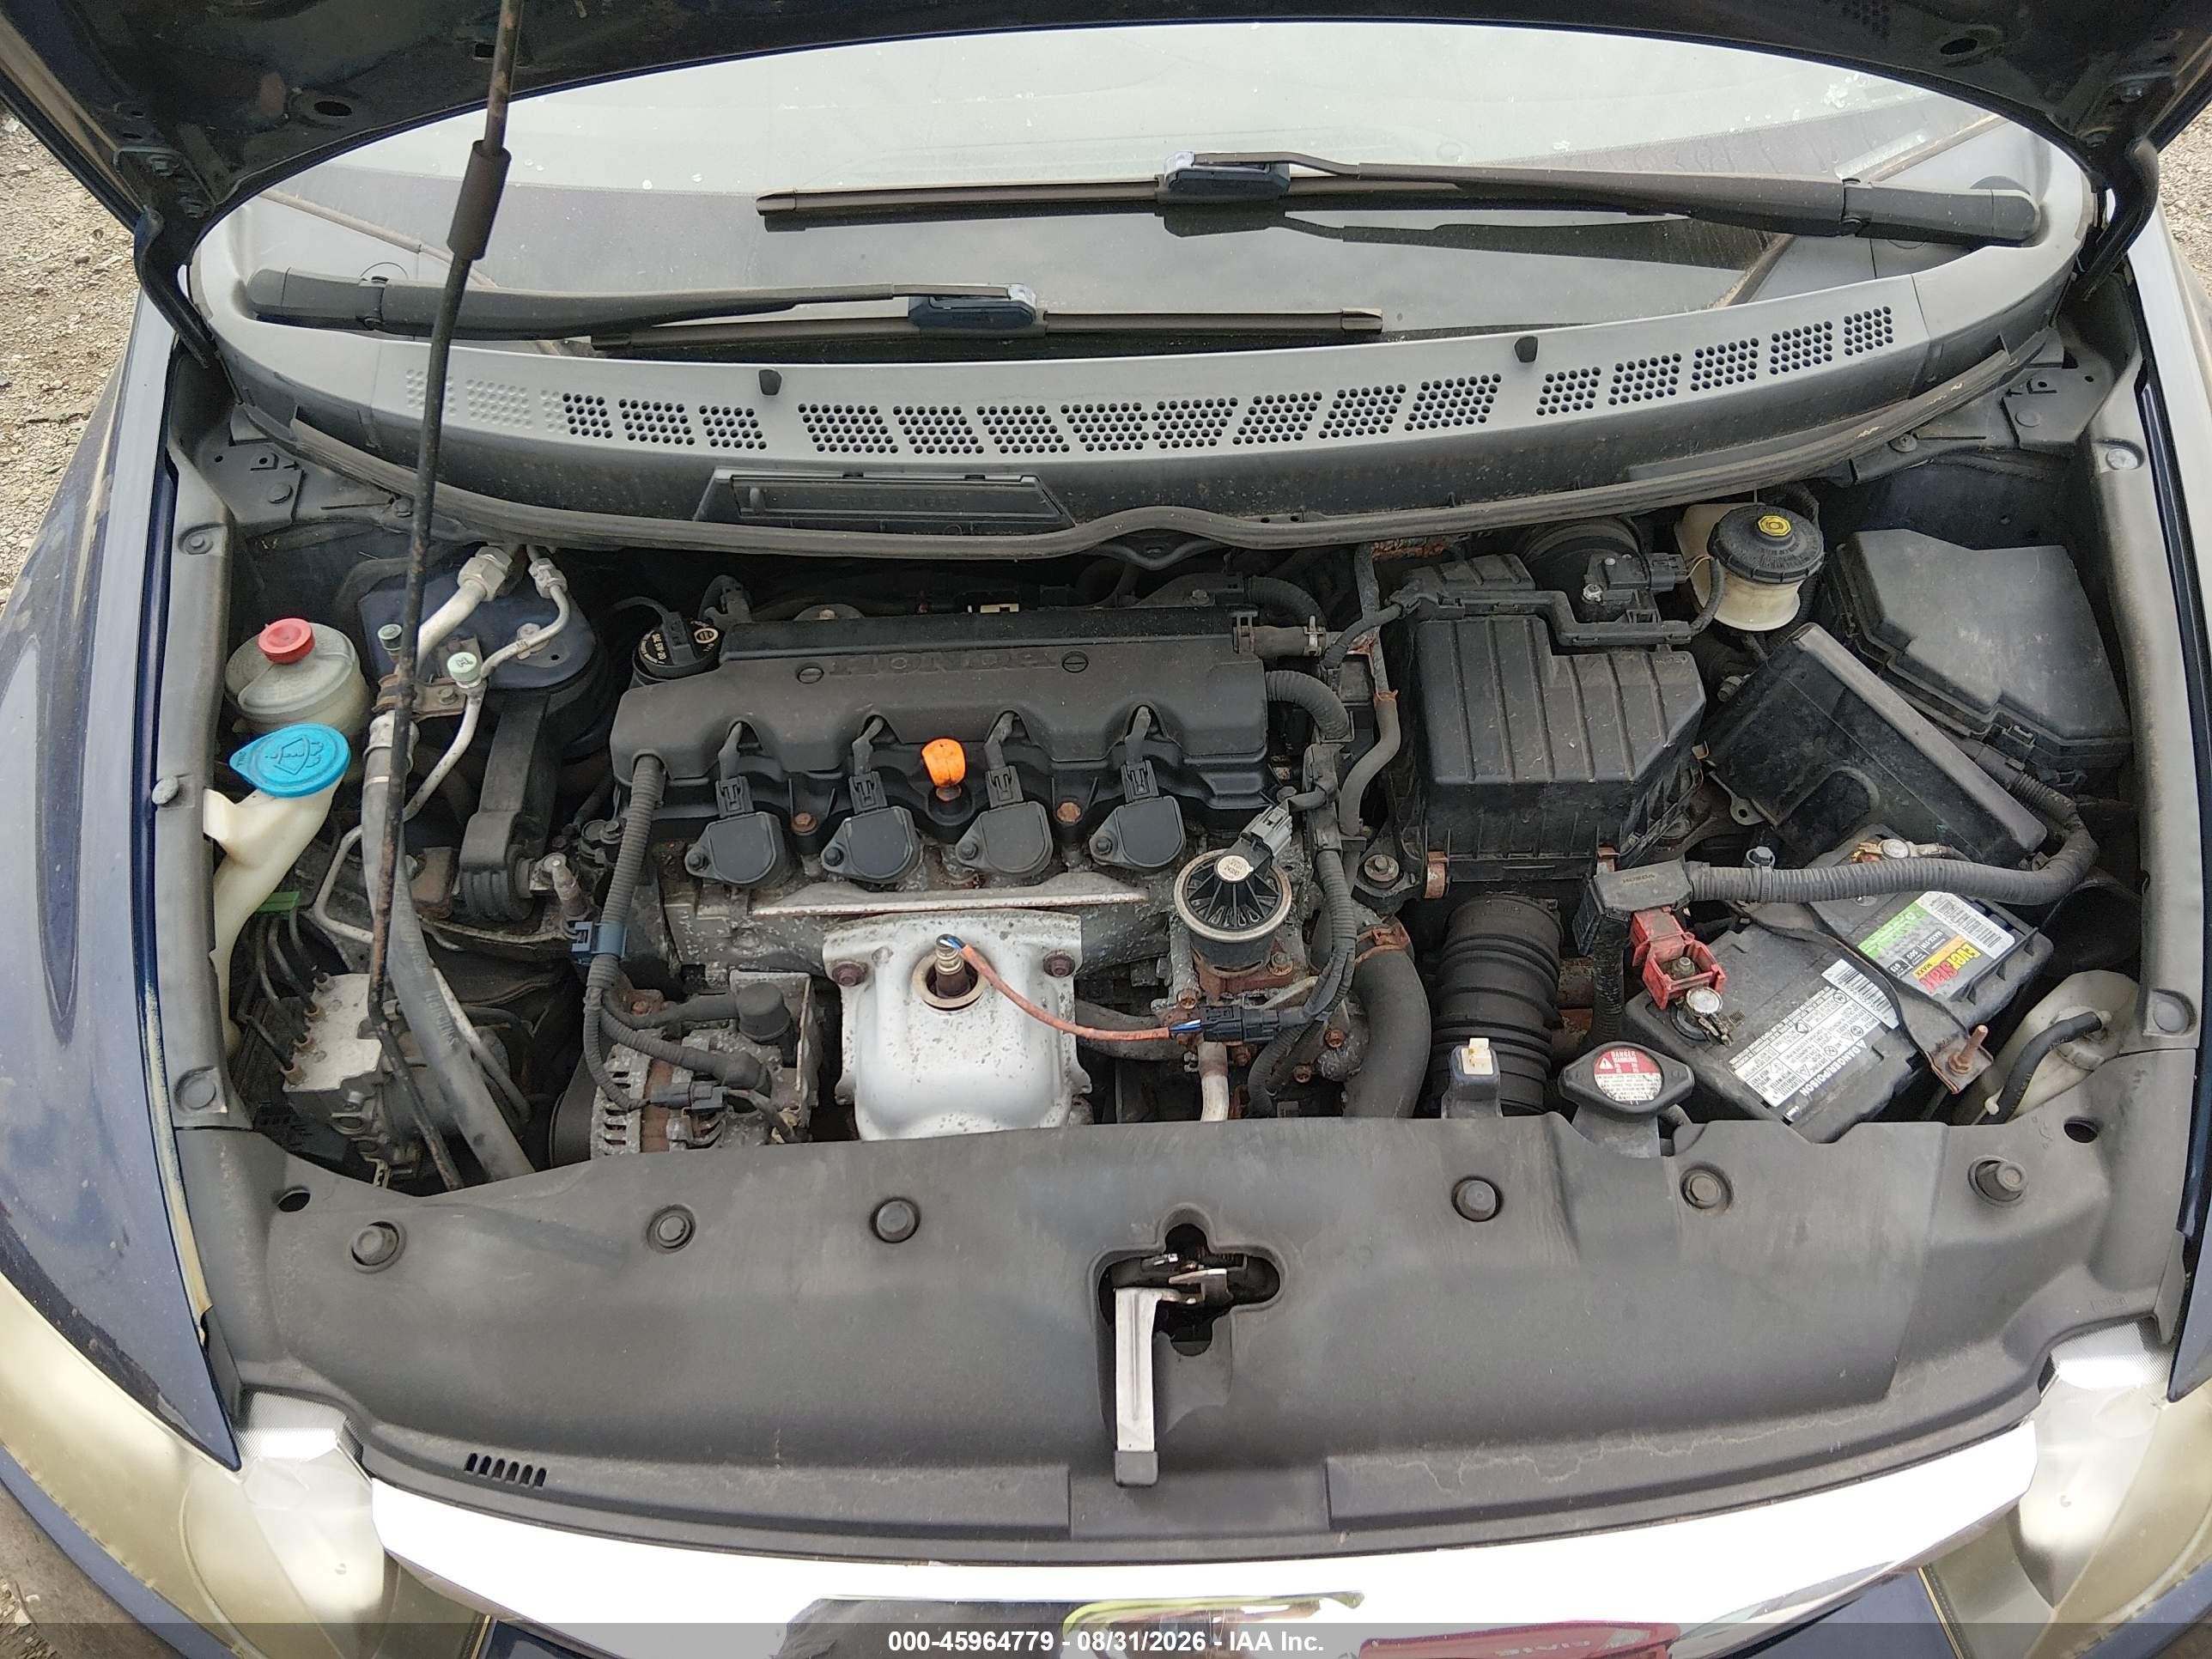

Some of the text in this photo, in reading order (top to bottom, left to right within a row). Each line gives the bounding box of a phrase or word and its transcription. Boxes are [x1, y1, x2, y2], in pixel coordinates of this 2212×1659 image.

[829, 653, 1057, 678] HONDA
[1916, 962, 1933, 977] MAXX
[1918, 943, 1982, 994] EverStart
[1610, 1050, 1637, 1059] DANGER
[1798, 1044, 1862, 1097] DANGER/POISON
